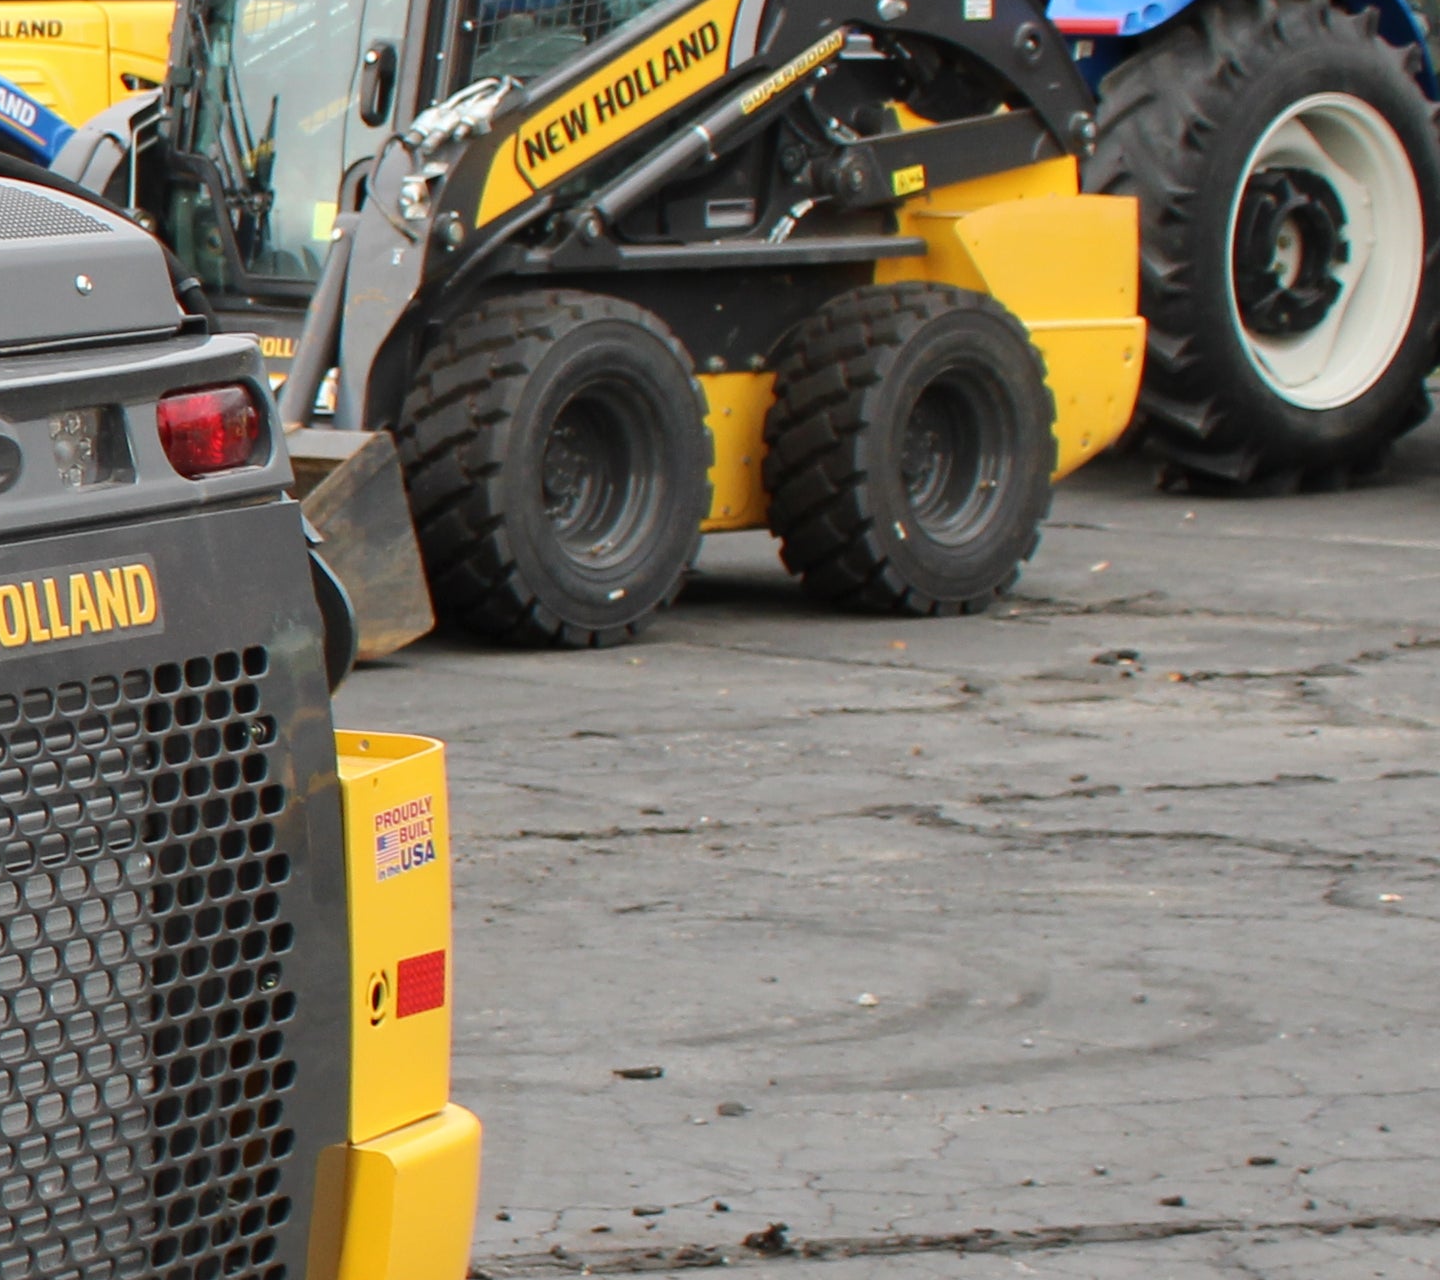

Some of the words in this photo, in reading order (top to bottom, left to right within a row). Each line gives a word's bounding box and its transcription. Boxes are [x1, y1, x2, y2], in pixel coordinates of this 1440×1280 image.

[741, 67, 794, 115] SUPER
[793, 29, 845, 78] BOOM
[524, 103, 588, 168] NEW
[593, 20, 720, 124] HOLLAND
[375, 795, 432, 832] PROUDLY
[399, 817, 434, 843] BUILT
[377, 870, 386, 881] in
[401, 838, 436, 871] USA
